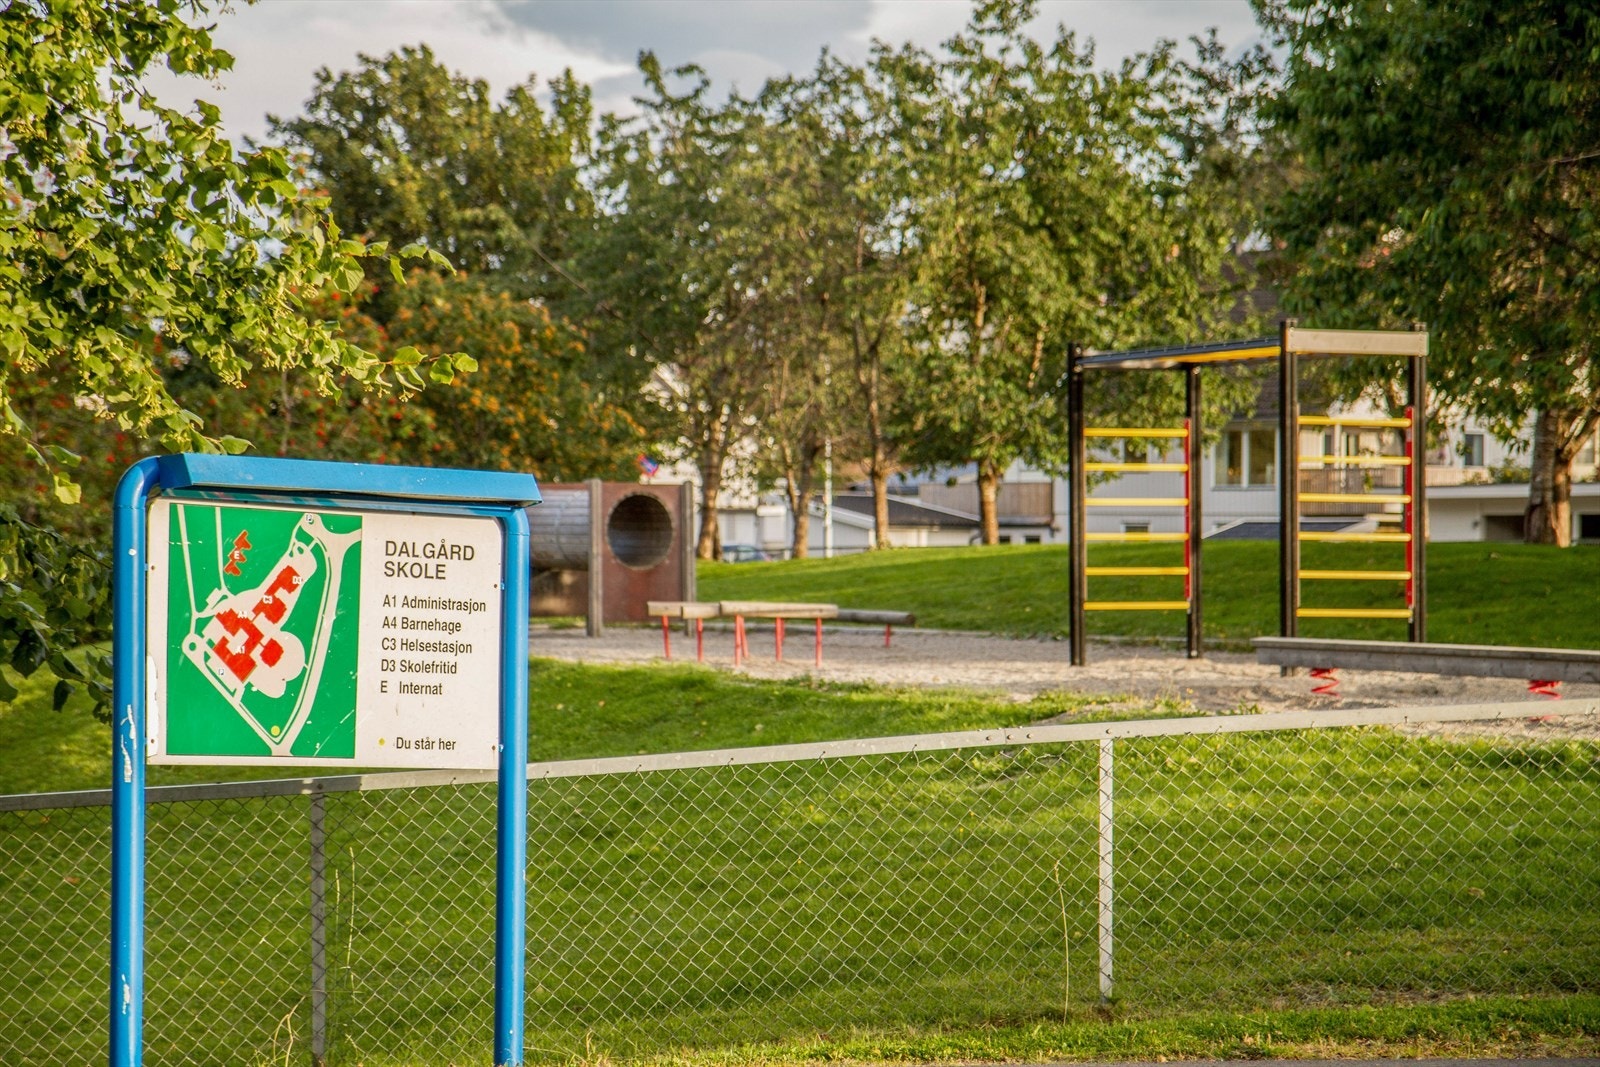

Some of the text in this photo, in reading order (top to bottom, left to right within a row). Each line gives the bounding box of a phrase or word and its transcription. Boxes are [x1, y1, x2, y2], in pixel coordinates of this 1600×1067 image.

[234, 551, 240, 560] E
[385, 539, 474, 561] DALGÅRD
[384, 561, 446, 580] SKOLE
[263, 595, 272, 604] C3
[383, 595, 486, 614] A1 Administrasjon
[383, 616, 461, 634] A4 Barnehage
[382, 638, 472, 656] C3 Helsestasjon
[381, 659, 457, 674] D3 Skolefritid
[381, 681, 442, 695] E Internat
[396, 737, 456, 750] Du står her
